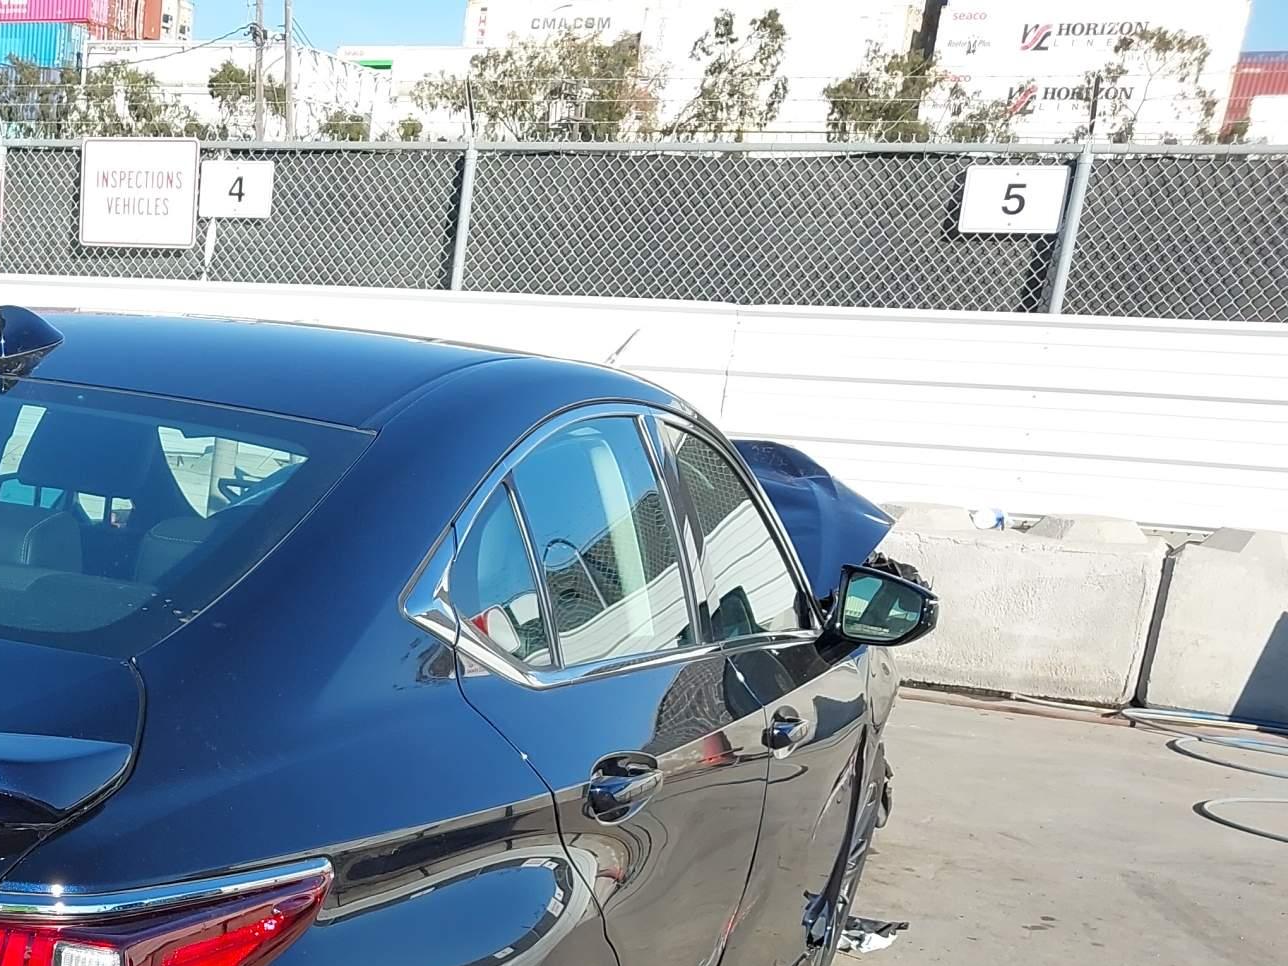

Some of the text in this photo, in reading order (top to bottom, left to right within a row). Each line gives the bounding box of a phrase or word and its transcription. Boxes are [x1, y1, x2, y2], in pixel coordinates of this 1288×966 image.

[530, 17, 567, 30] CMA
[952, 12, 988, 20] seaco
[1056, 21, 1149, 36] HORIZON
[1042, 86, 1134, 100] HORIZON
[96, 170, 183, 189] INSPECTIONS
[228, 175, 245, 203] 4
[106, 197, 170, 216] VEHICLES
[1001, 183, 1027, 215] 5
